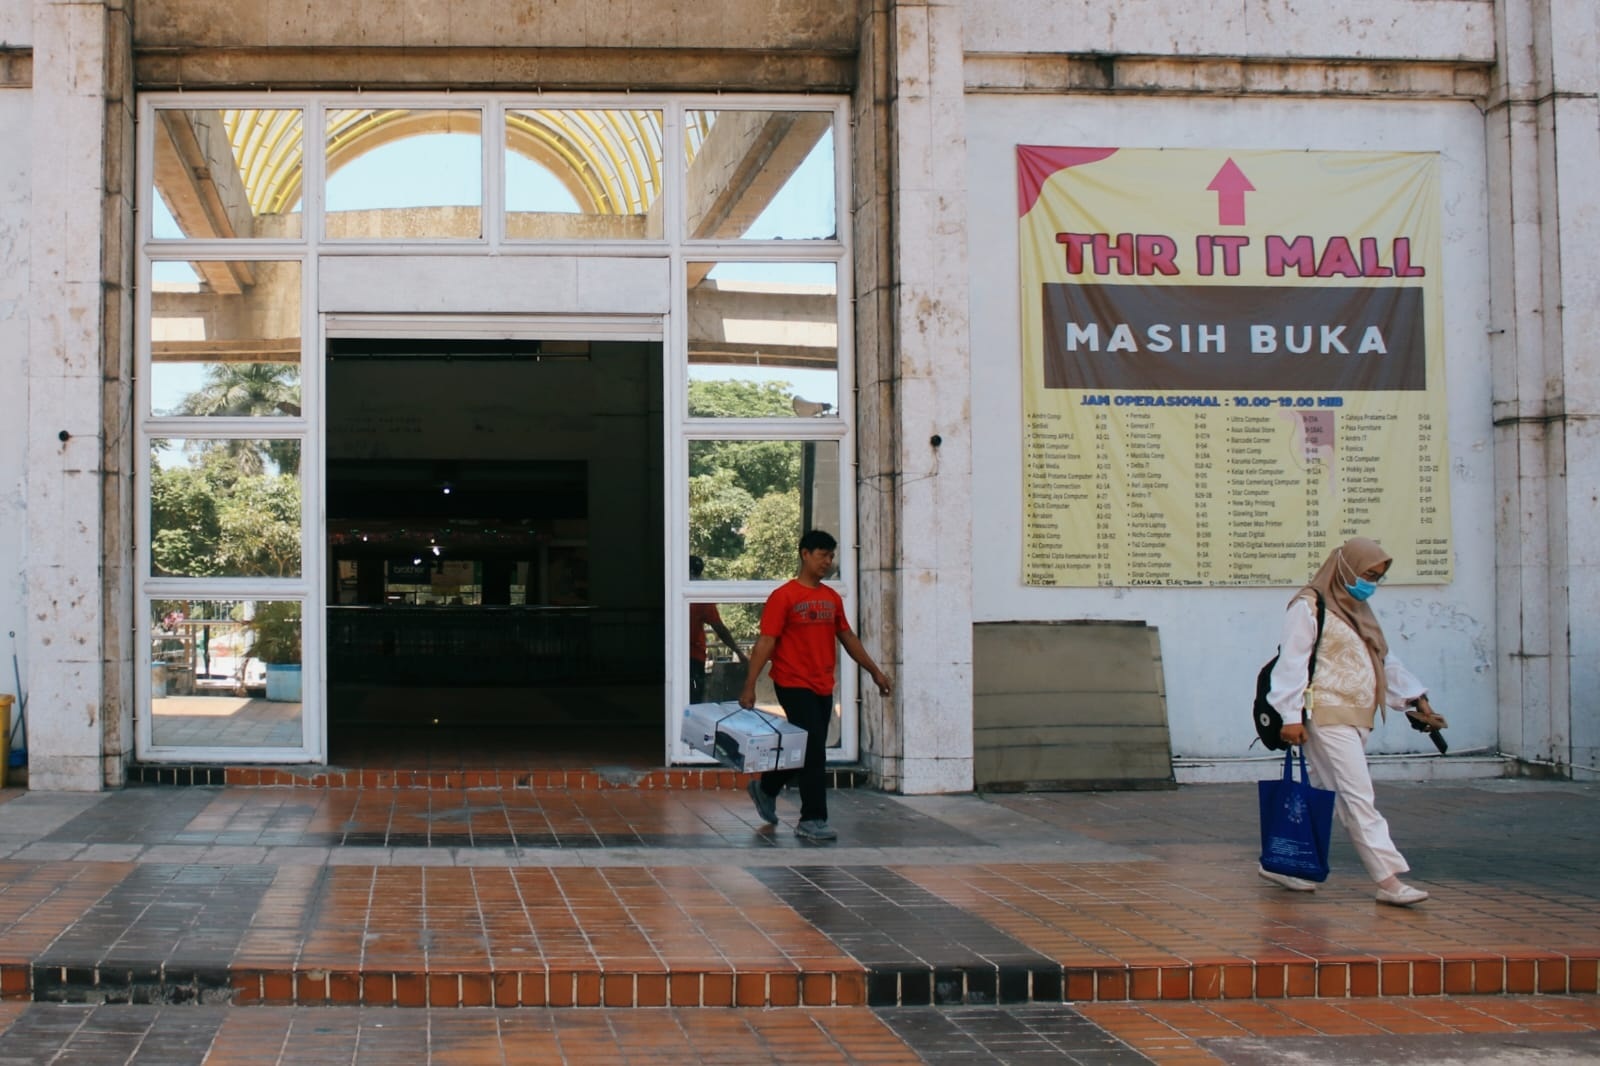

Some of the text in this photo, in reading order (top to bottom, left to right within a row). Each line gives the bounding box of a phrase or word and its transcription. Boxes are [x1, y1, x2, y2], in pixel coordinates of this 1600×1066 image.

[1055, 232, 1426, 278] THR IT MALL
[1066, 322, 1388, 355] MASIH BUKA
[1080, 394, 1110, 406] JAM
[1114, 395, 1221, 407] OPERASIONAL
[1233, 396, 1314, 407] 10.00-19.00
[1245, 416, 1270, 424] Computer
[1146, 433, 1161, 441] Comp
[1046, 443, 1069, 451] Computer
[1151, 453, 1165, 461] Comp
[1354, 456, 1380, 464] Computer
[1252, 458, 1277, 466] Computer
[1068, 473, 1092, 481] Computer
[1274, 479, 1300, 487] Computer
[1359, 487, 1384, 495] Computer
[1064, 493, 1088, 501] Computer
[1249, 531, 1265, 539] Digital
[1038, 543, 1063, 551] Computer
[1242, 552, 1257, 560] Comp
[1278, 552, 1296, 560] Laptop
[1148, 561, 1172, 569] Computer
[1146, 571, 1170, 579] Computer
